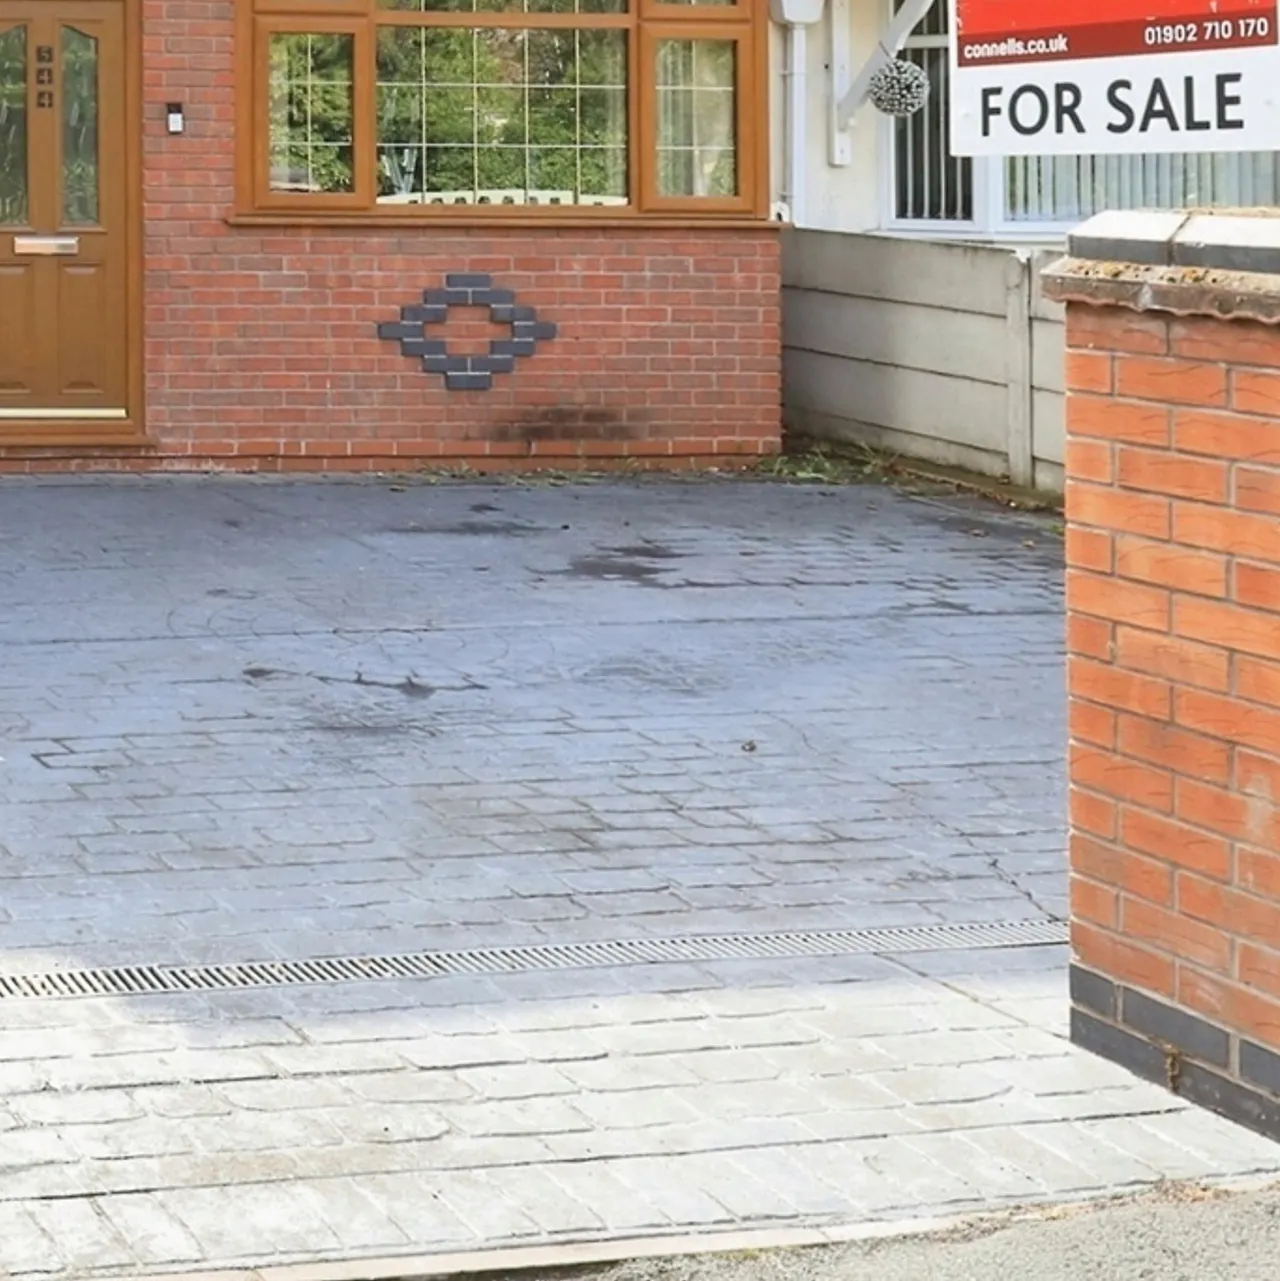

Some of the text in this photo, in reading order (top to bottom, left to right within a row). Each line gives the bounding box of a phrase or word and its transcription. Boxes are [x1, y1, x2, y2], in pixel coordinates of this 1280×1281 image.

[1144, 18, 1268, 45] 01902 710 170
[964, 33, 1068, 58] connells.co.uk
[981, 72, 1245, 137] FOR SALE
